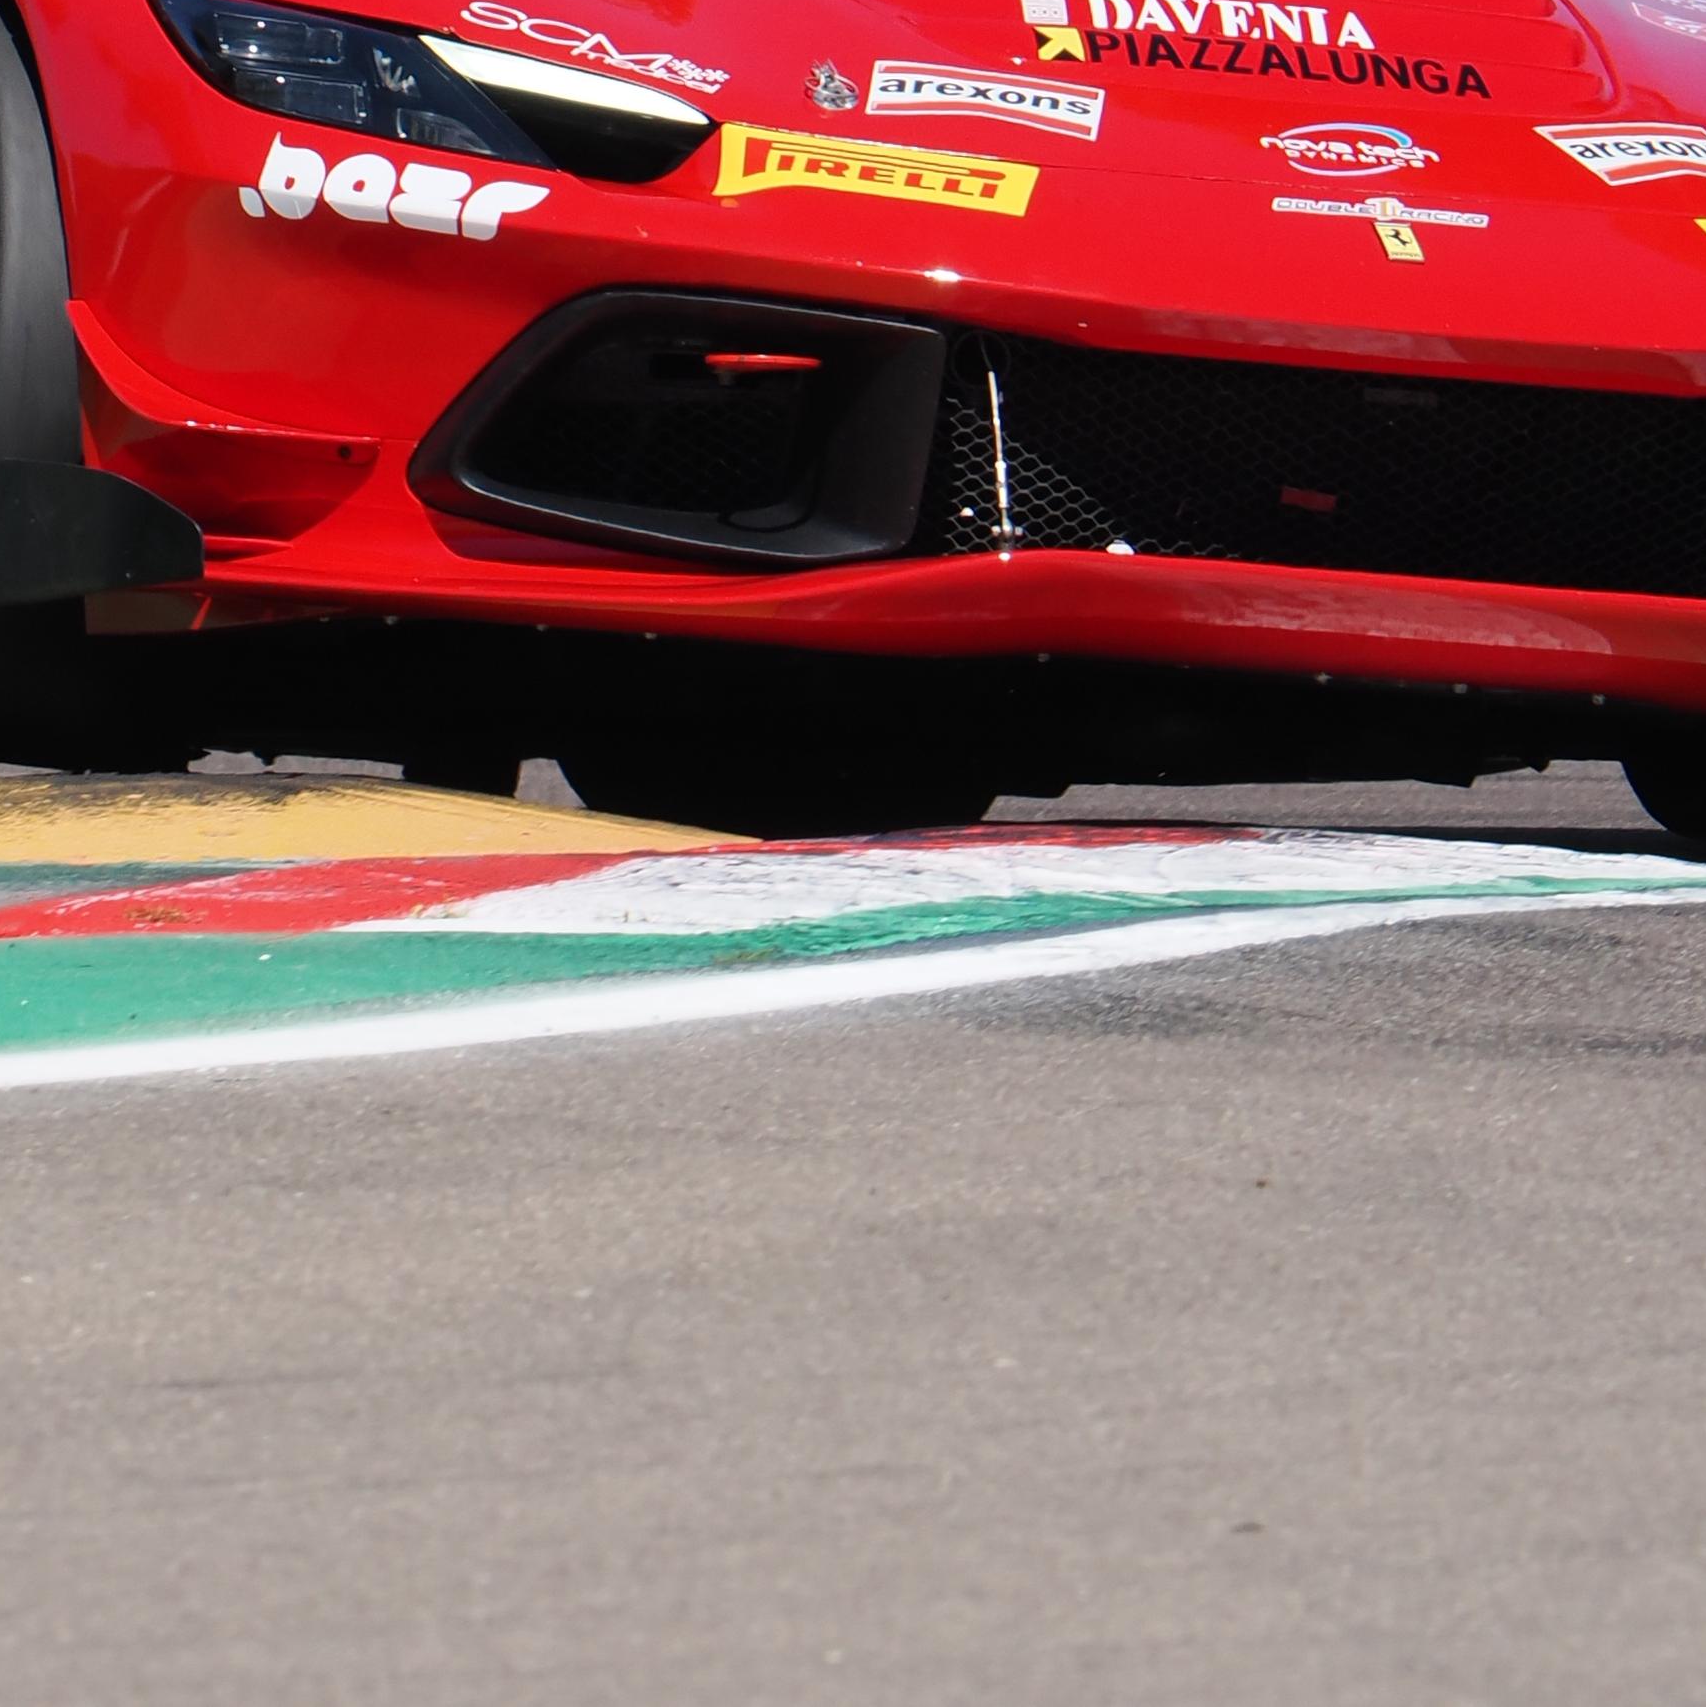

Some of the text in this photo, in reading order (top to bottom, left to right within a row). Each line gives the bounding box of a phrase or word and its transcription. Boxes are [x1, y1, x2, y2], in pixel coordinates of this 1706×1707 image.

[460, 1, 674, 71] SCM
[1087, 29, 1492, 99] PIAZZALUNGA
[878, 77, 1093, 116] arexons
[743, 137, 1007, 200] PIRELLI
[1259, 136, 1440, 162] nova tech
